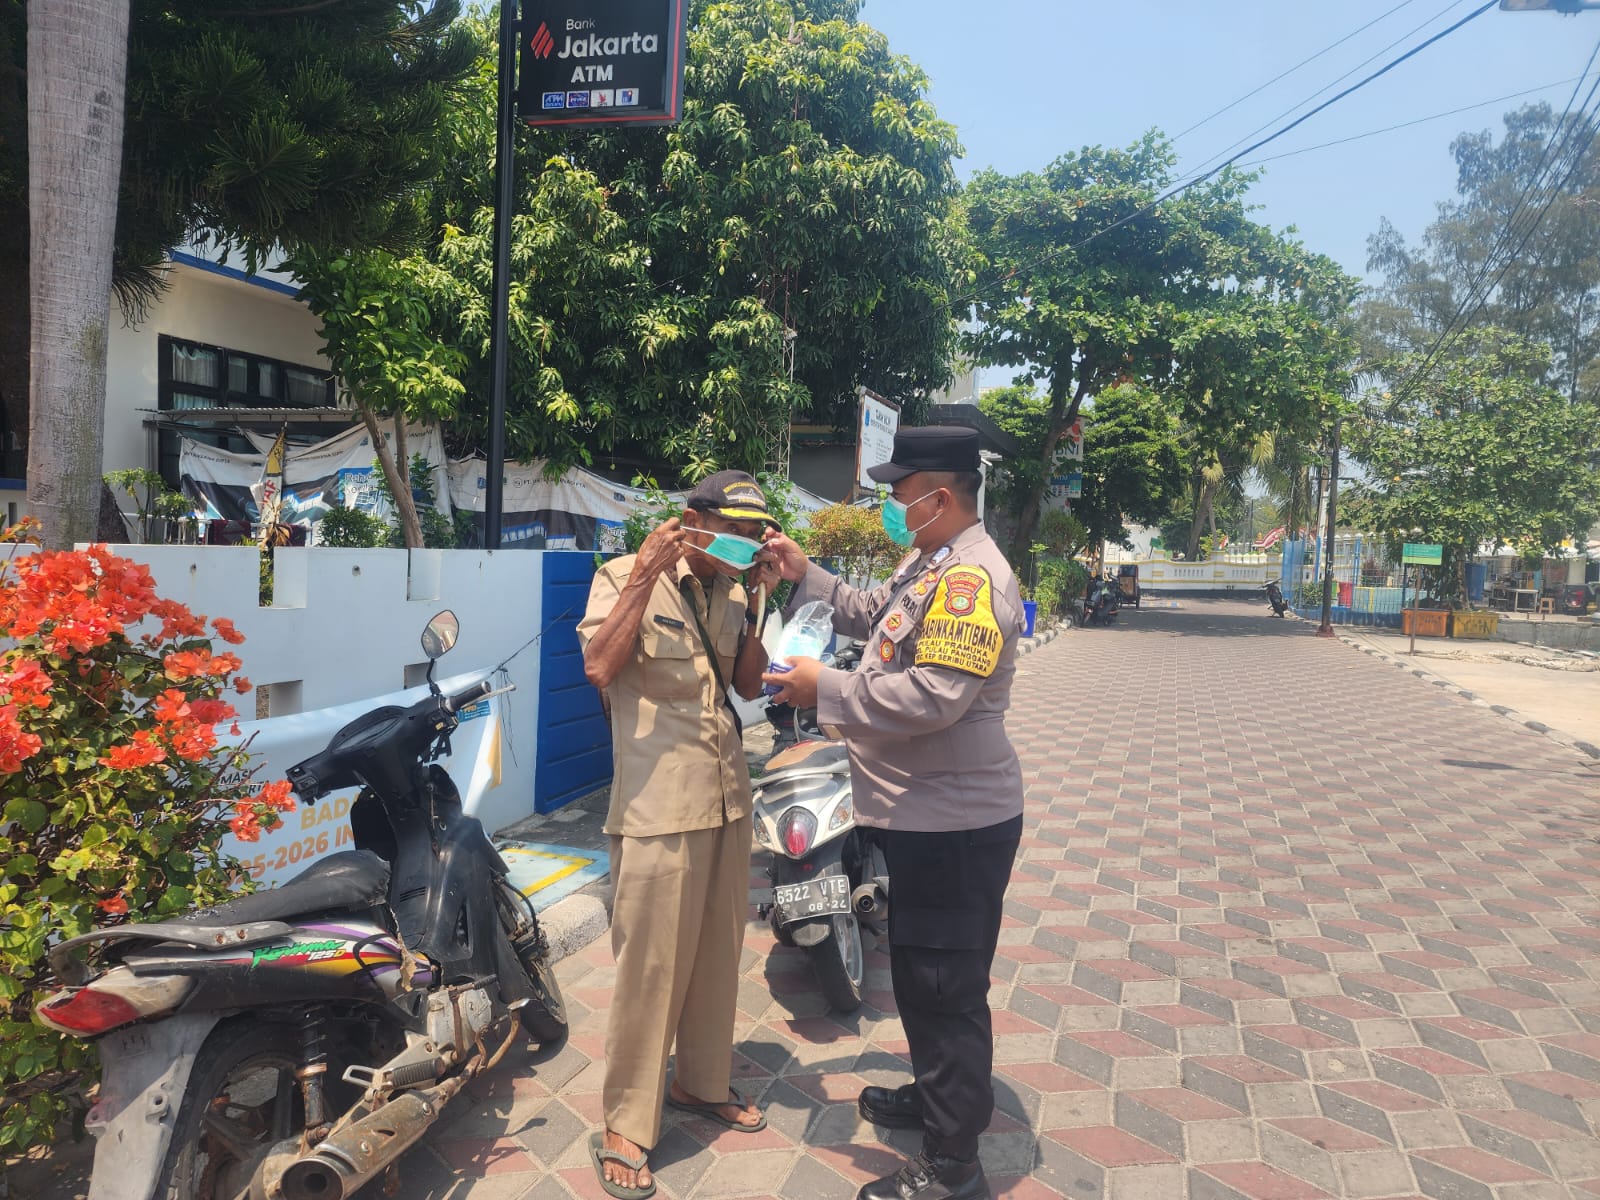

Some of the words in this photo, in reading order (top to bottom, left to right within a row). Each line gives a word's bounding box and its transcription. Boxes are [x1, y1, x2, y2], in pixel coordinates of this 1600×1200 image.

[566, 18, 596, 30] Bank
[557, 31, 659, 59] Jakarta
[570, 64, 613, 83] ATM
[901, 594, 916, 615] POLRI
[925, 646, 949, 655] PULAU
[950, 650, 990, 666] PANGGANG
[944, 642, 987, 657] PRAMUKA
[939, 655, 964, 665] SERIBU
[966, 662, 987, 672] UTARA
[776, 885, 811, 905] 6522
[819, 879, 847, 897] VTE
[307, 948, 347, 962] 125D
